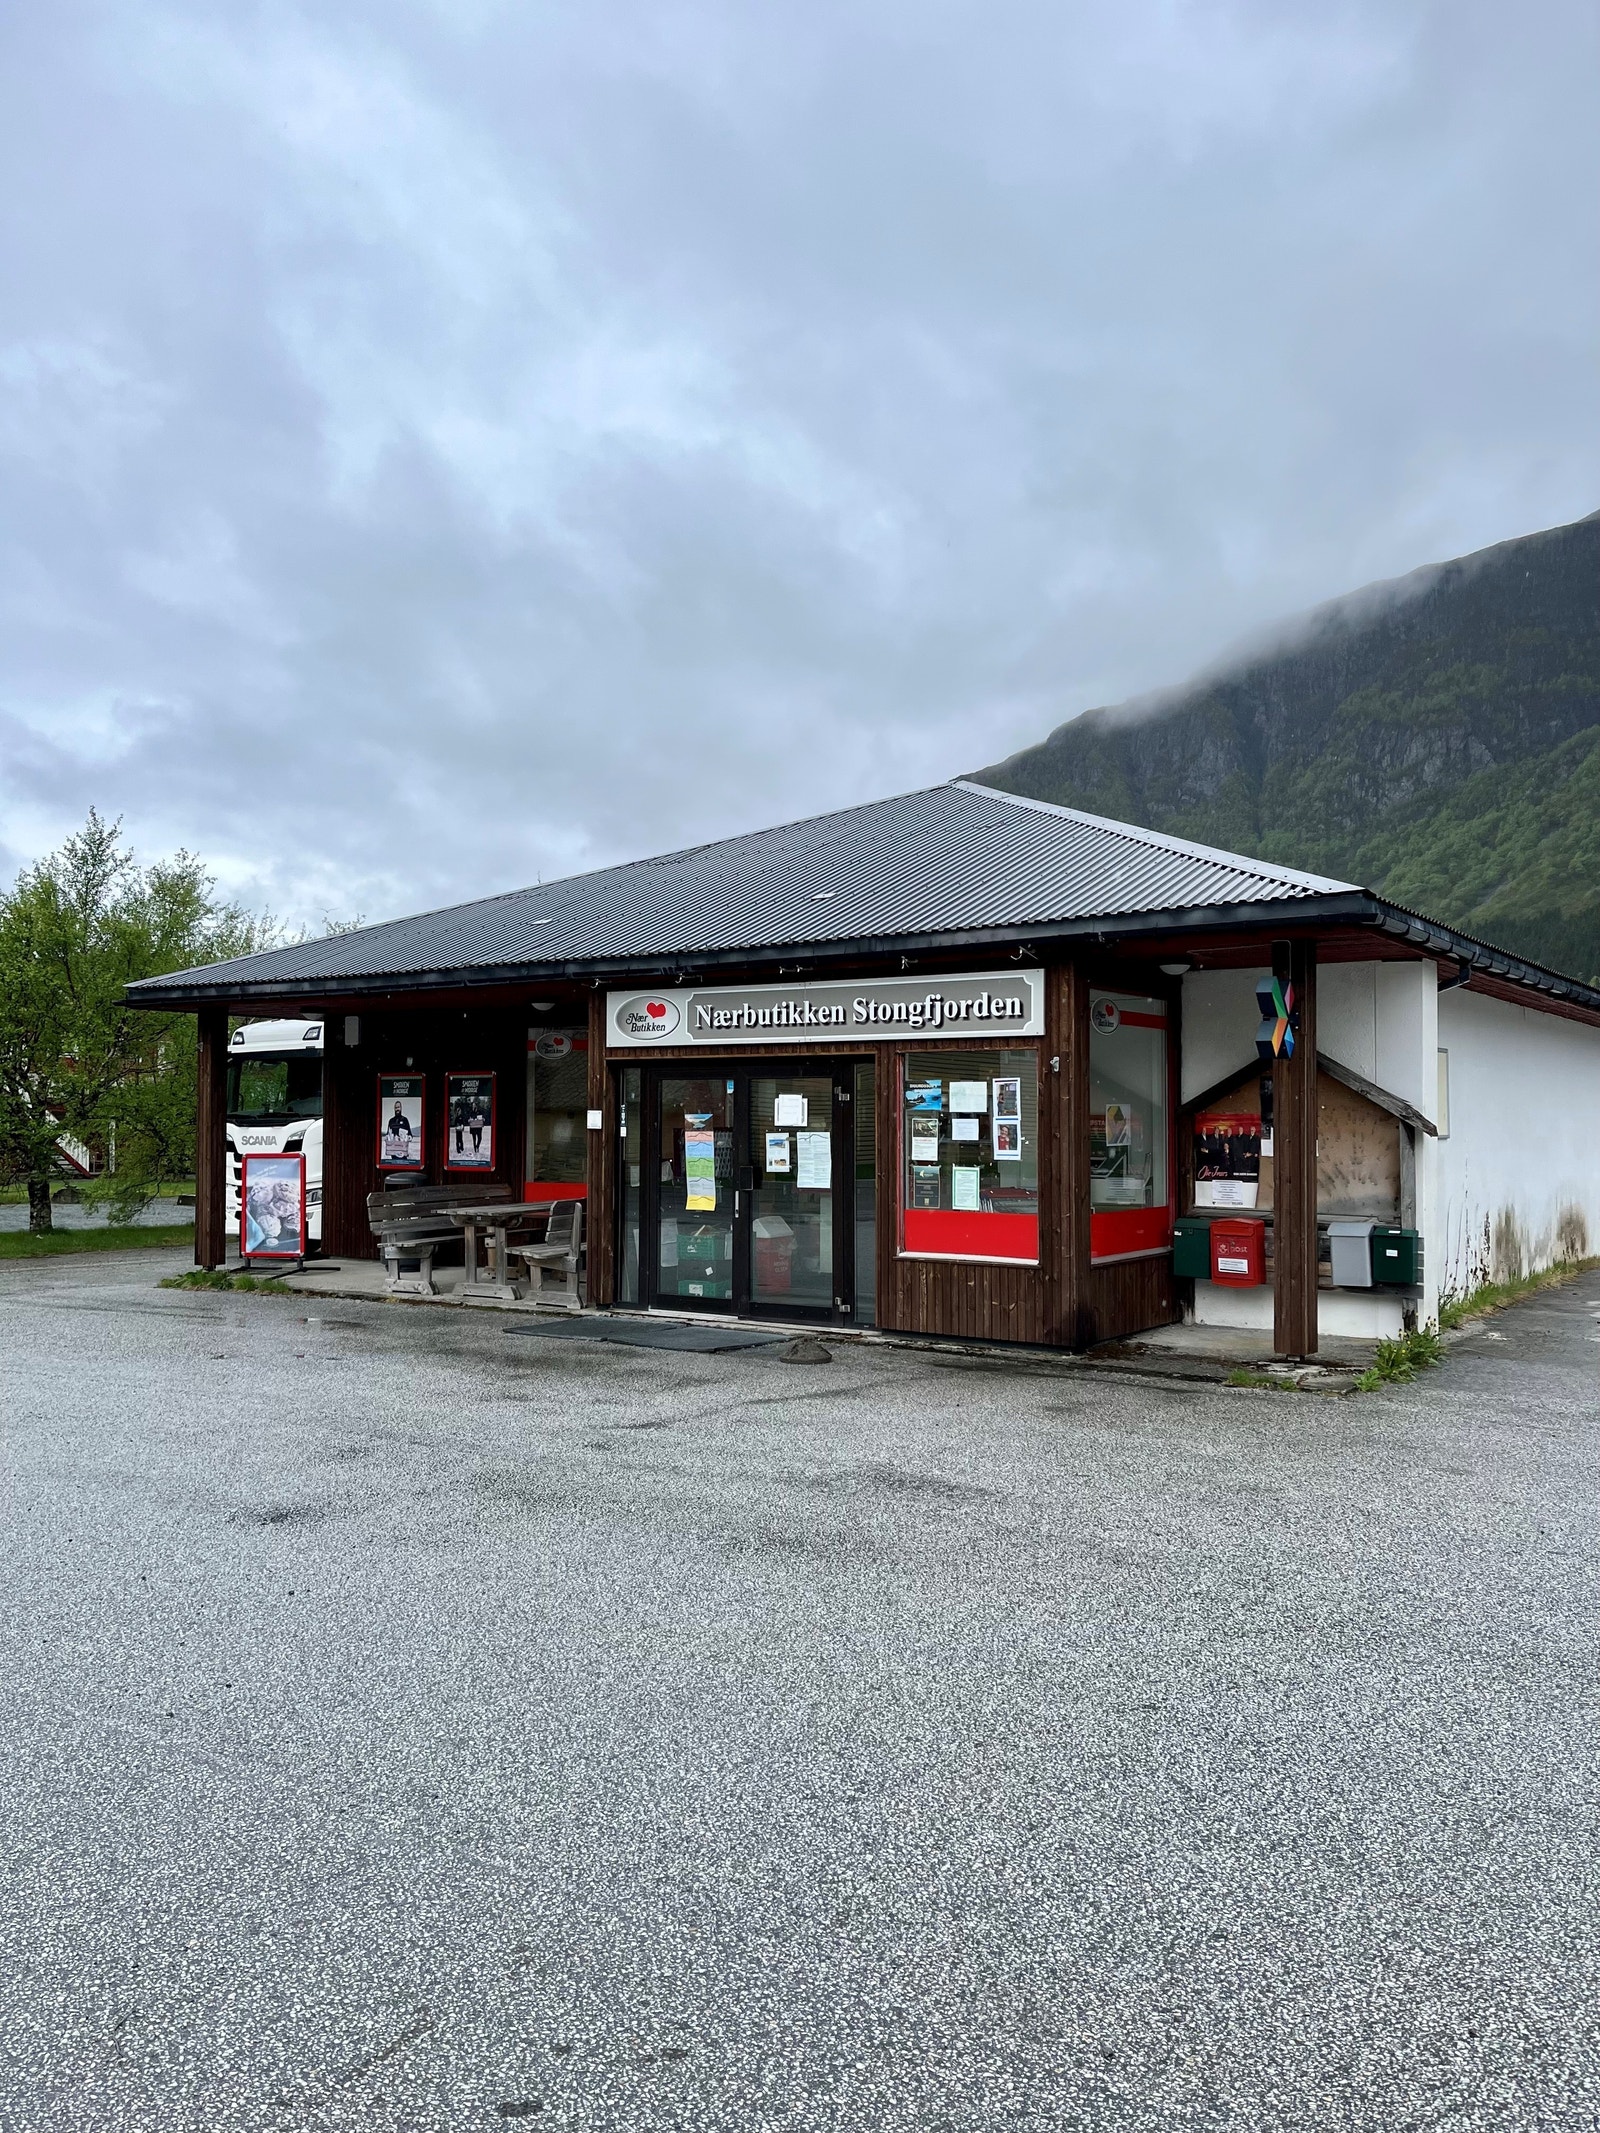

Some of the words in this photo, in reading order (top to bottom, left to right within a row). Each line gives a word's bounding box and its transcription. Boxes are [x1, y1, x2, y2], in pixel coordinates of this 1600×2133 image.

[694, 1000, 845, 1028] Nærbutikken
[852, 991, 1022, 1026] Stongfjorden
[625, 1012, 648, 1023] Nær
[630, 1022, 666, 1032] Butikken
[241, 1135, 278, 1146] SCANIA
